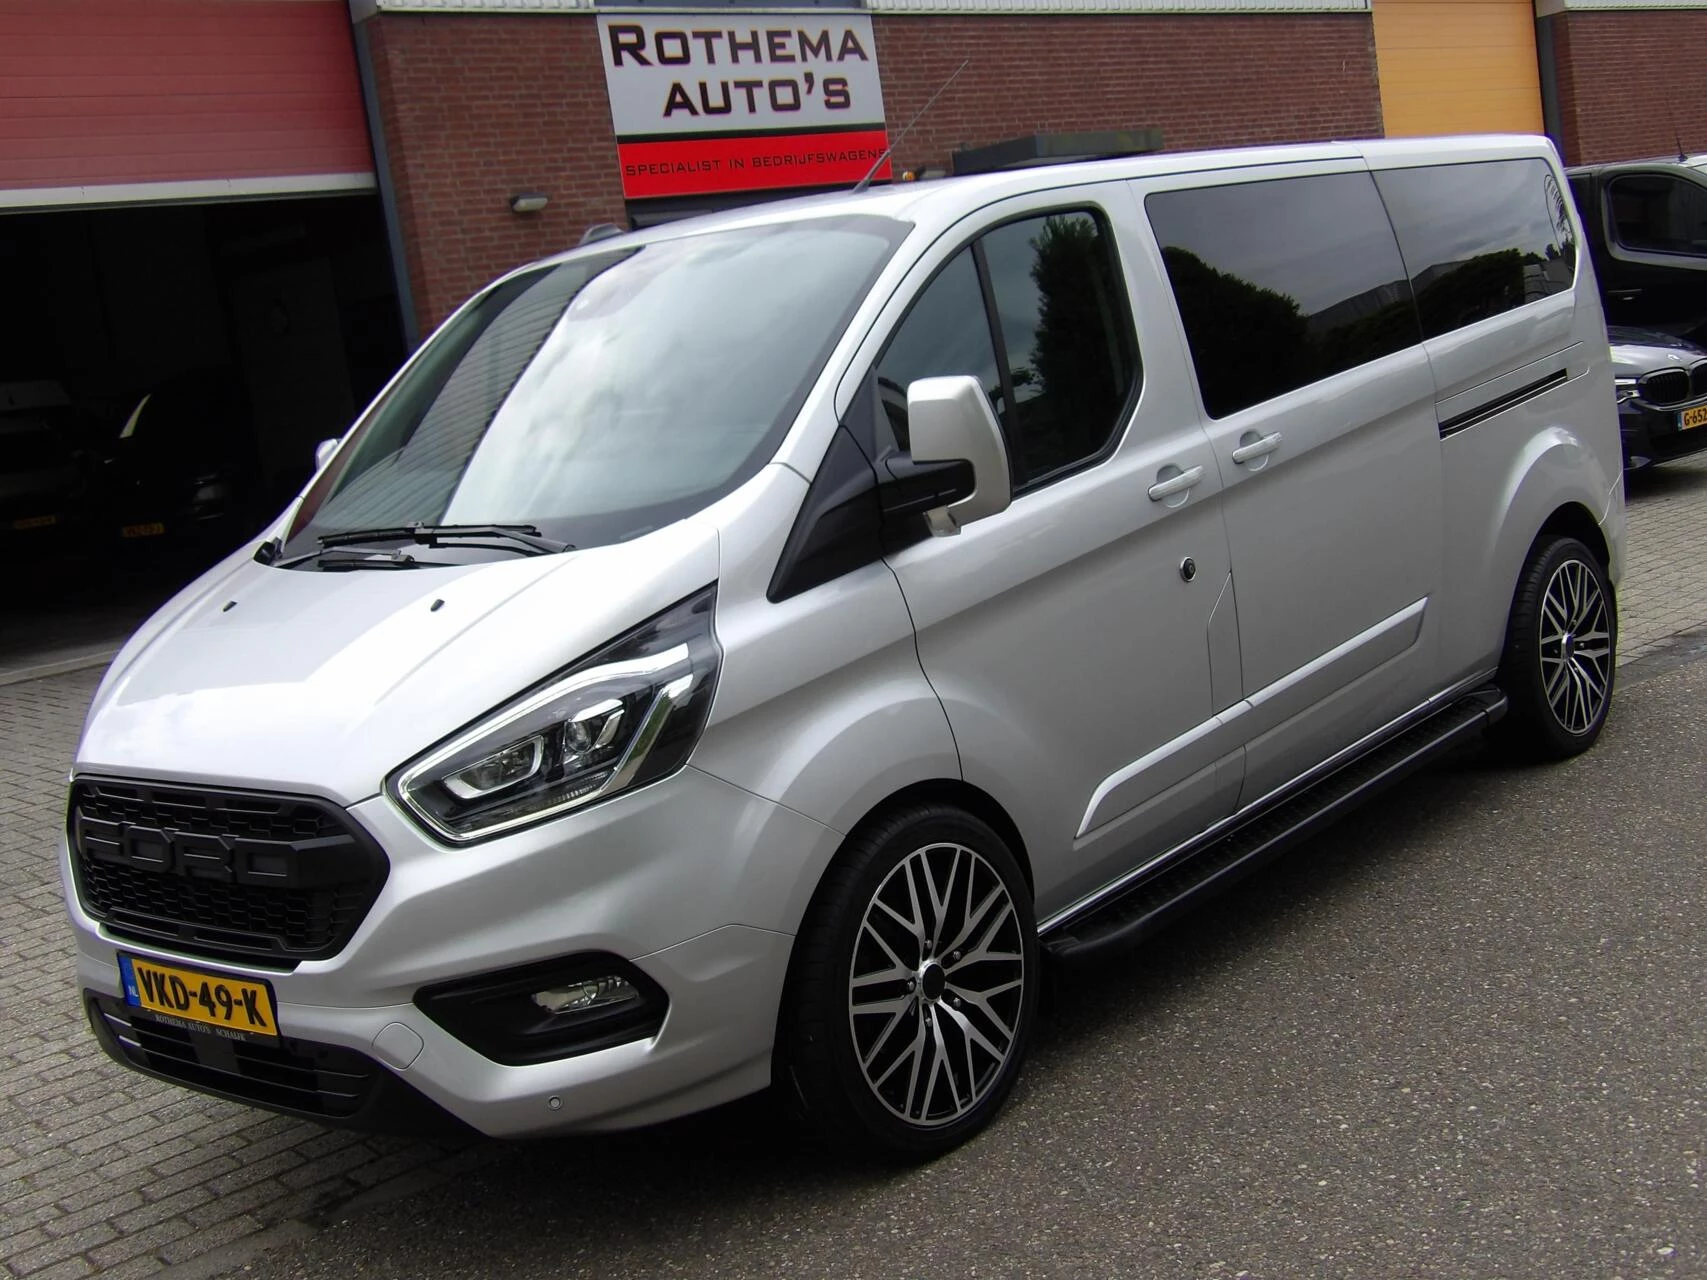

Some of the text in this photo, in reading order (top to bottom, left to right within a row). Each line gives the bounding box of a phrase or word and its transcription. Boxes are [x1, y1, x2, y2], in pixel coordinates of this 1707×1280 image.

[608, 24, 868, 67] ROTHEMA
[663, 72, 851, 117] AUTO'S
[625, 159, 721, 176] SPECIALIST
[729, 158, 745, 170] IN
[137, 967, 267, 1027] VKD-49-K
